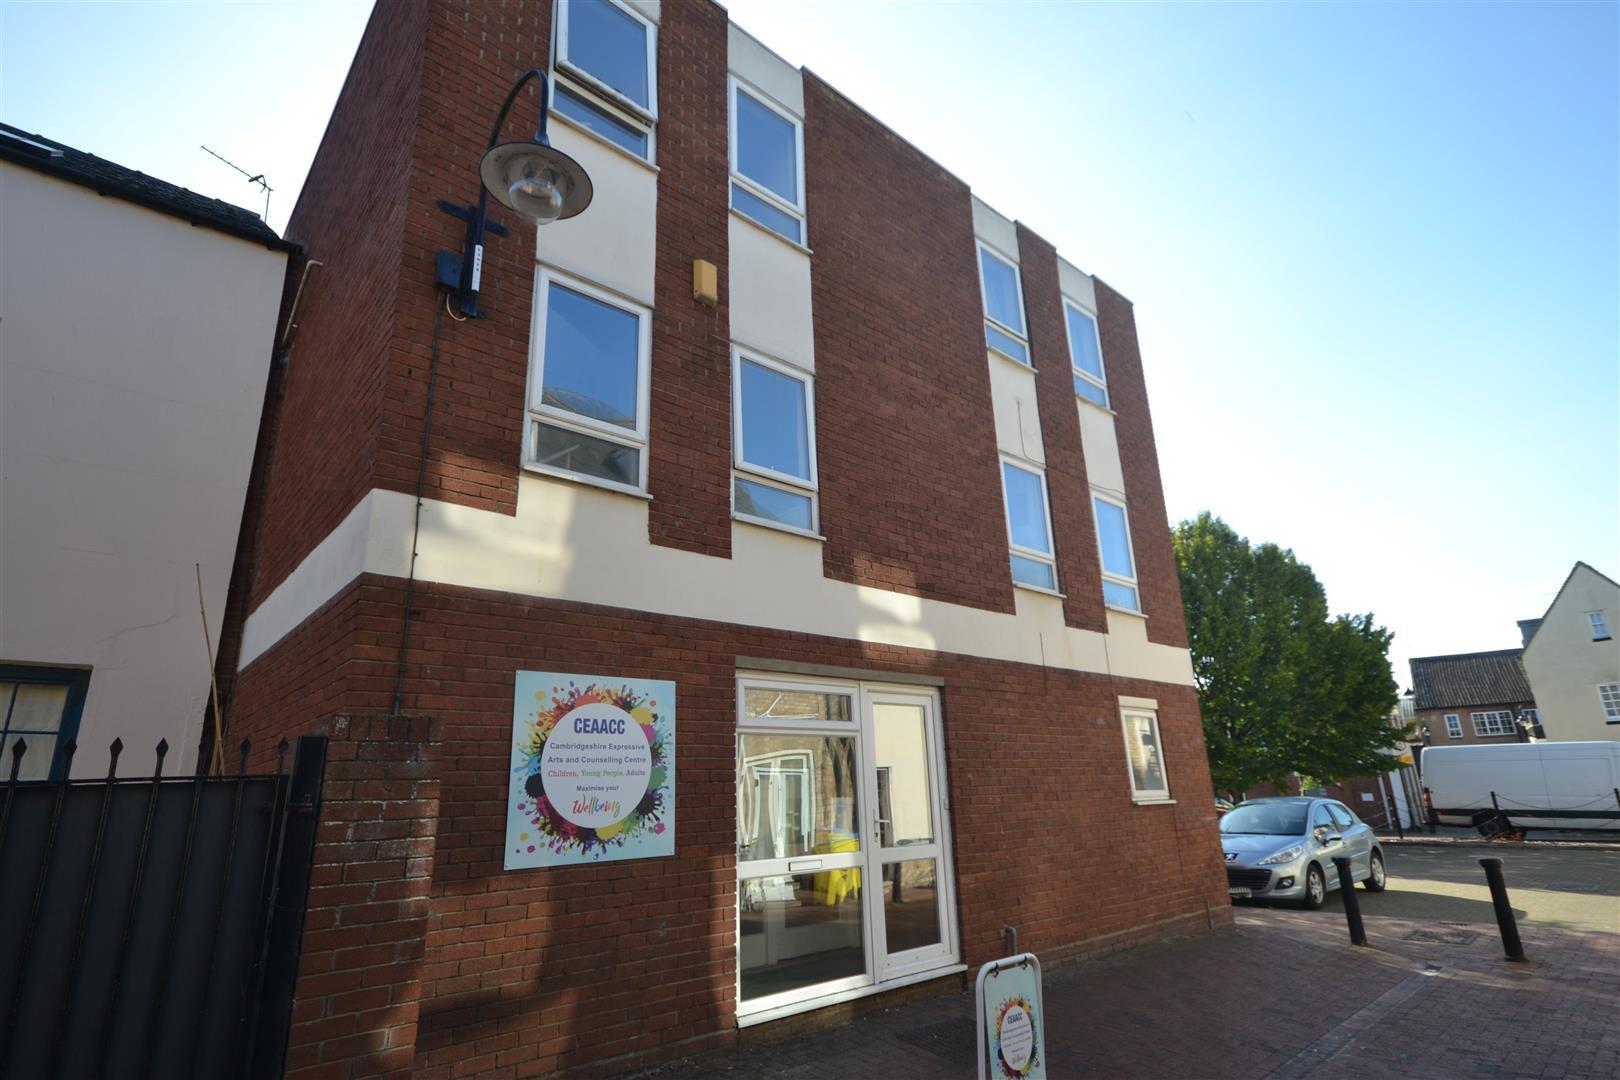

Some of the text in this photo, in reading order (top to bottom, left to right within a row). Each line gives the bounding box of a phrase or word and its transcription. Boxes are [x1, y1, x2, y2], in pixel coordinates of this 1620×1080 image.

[574, 718, 625, 734] CEAACC
[550, 742, 645, 751] Cambridgeshire Expressive
[581, 756, 622, 764] Counselling
[581, 770, 601, 778] Young
[572, 794, 621, 818] Wellbeing
